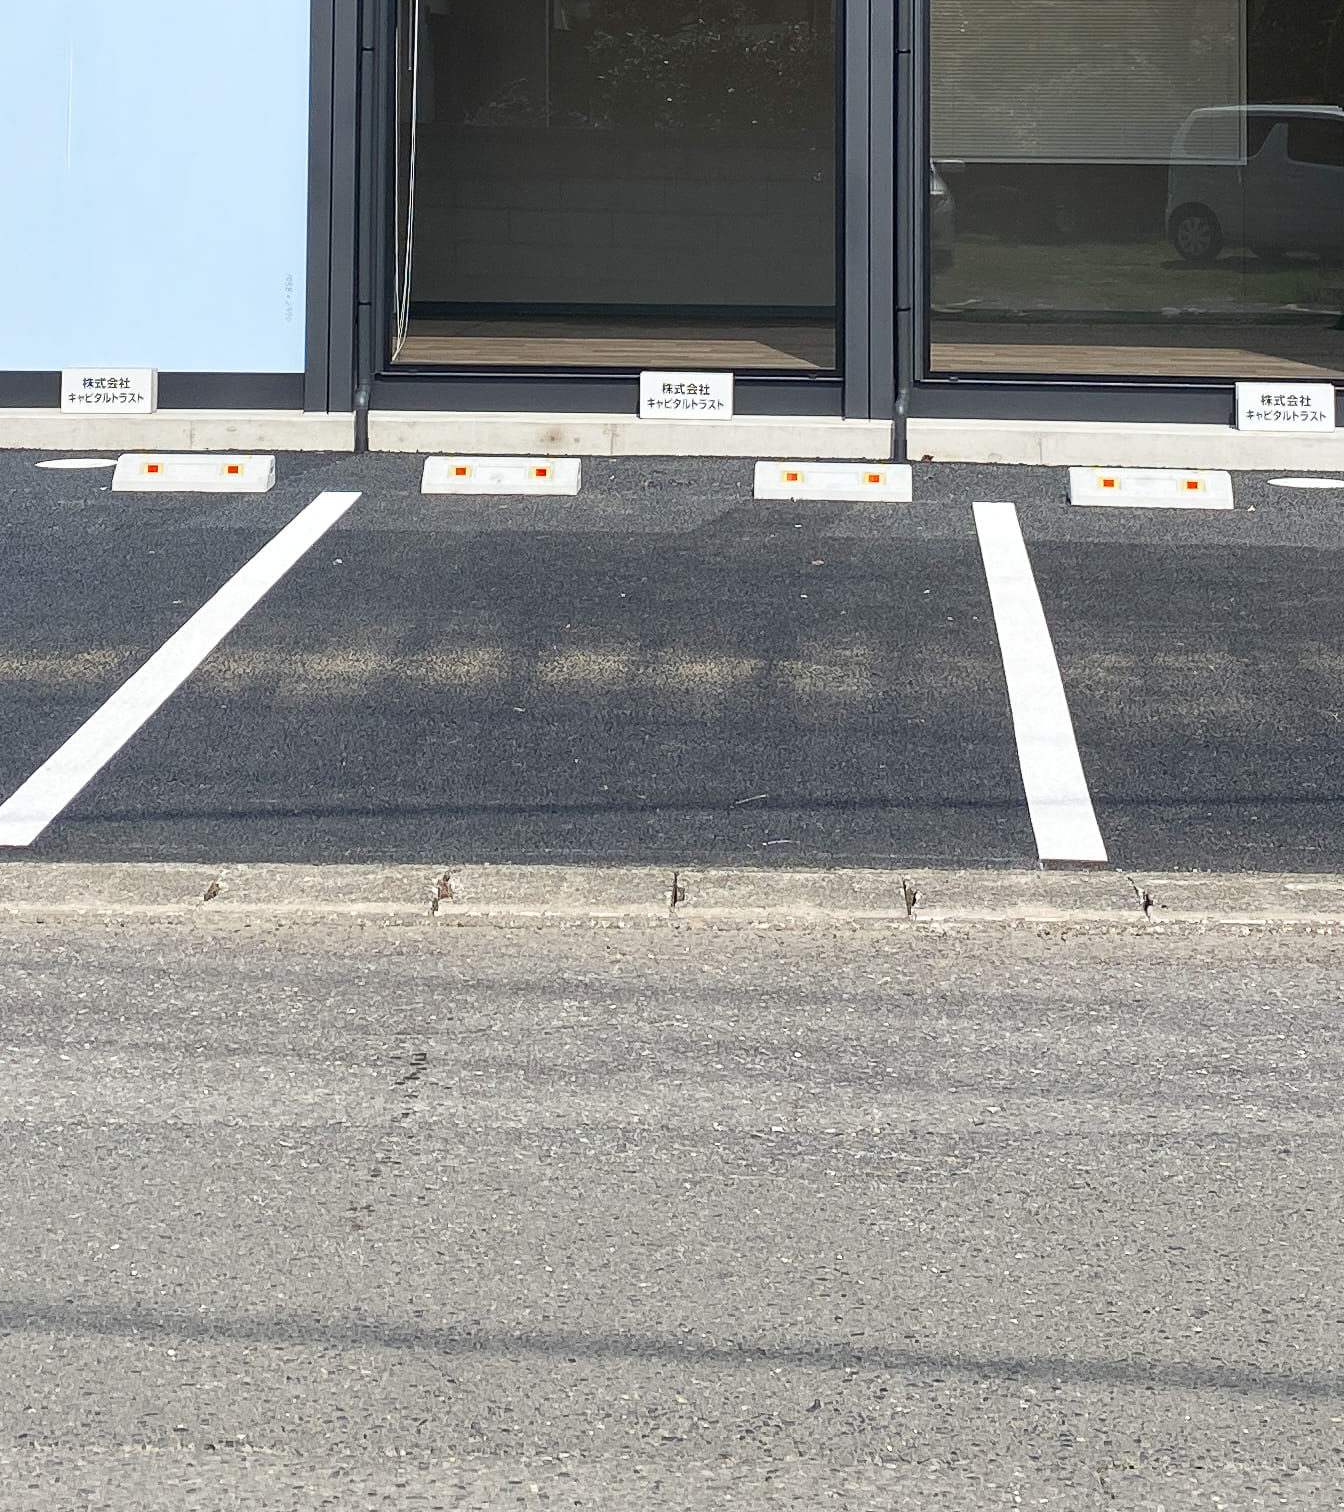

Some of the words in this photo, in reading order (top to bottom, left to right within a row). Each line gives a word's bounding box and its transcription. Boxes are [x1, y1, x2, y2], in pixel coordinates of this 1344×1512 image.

[82, 377, 131, 389] 株式会社
[662, 382, 711, 396] 株式会社
[1261, 394, 1312, 407] 株式会社
